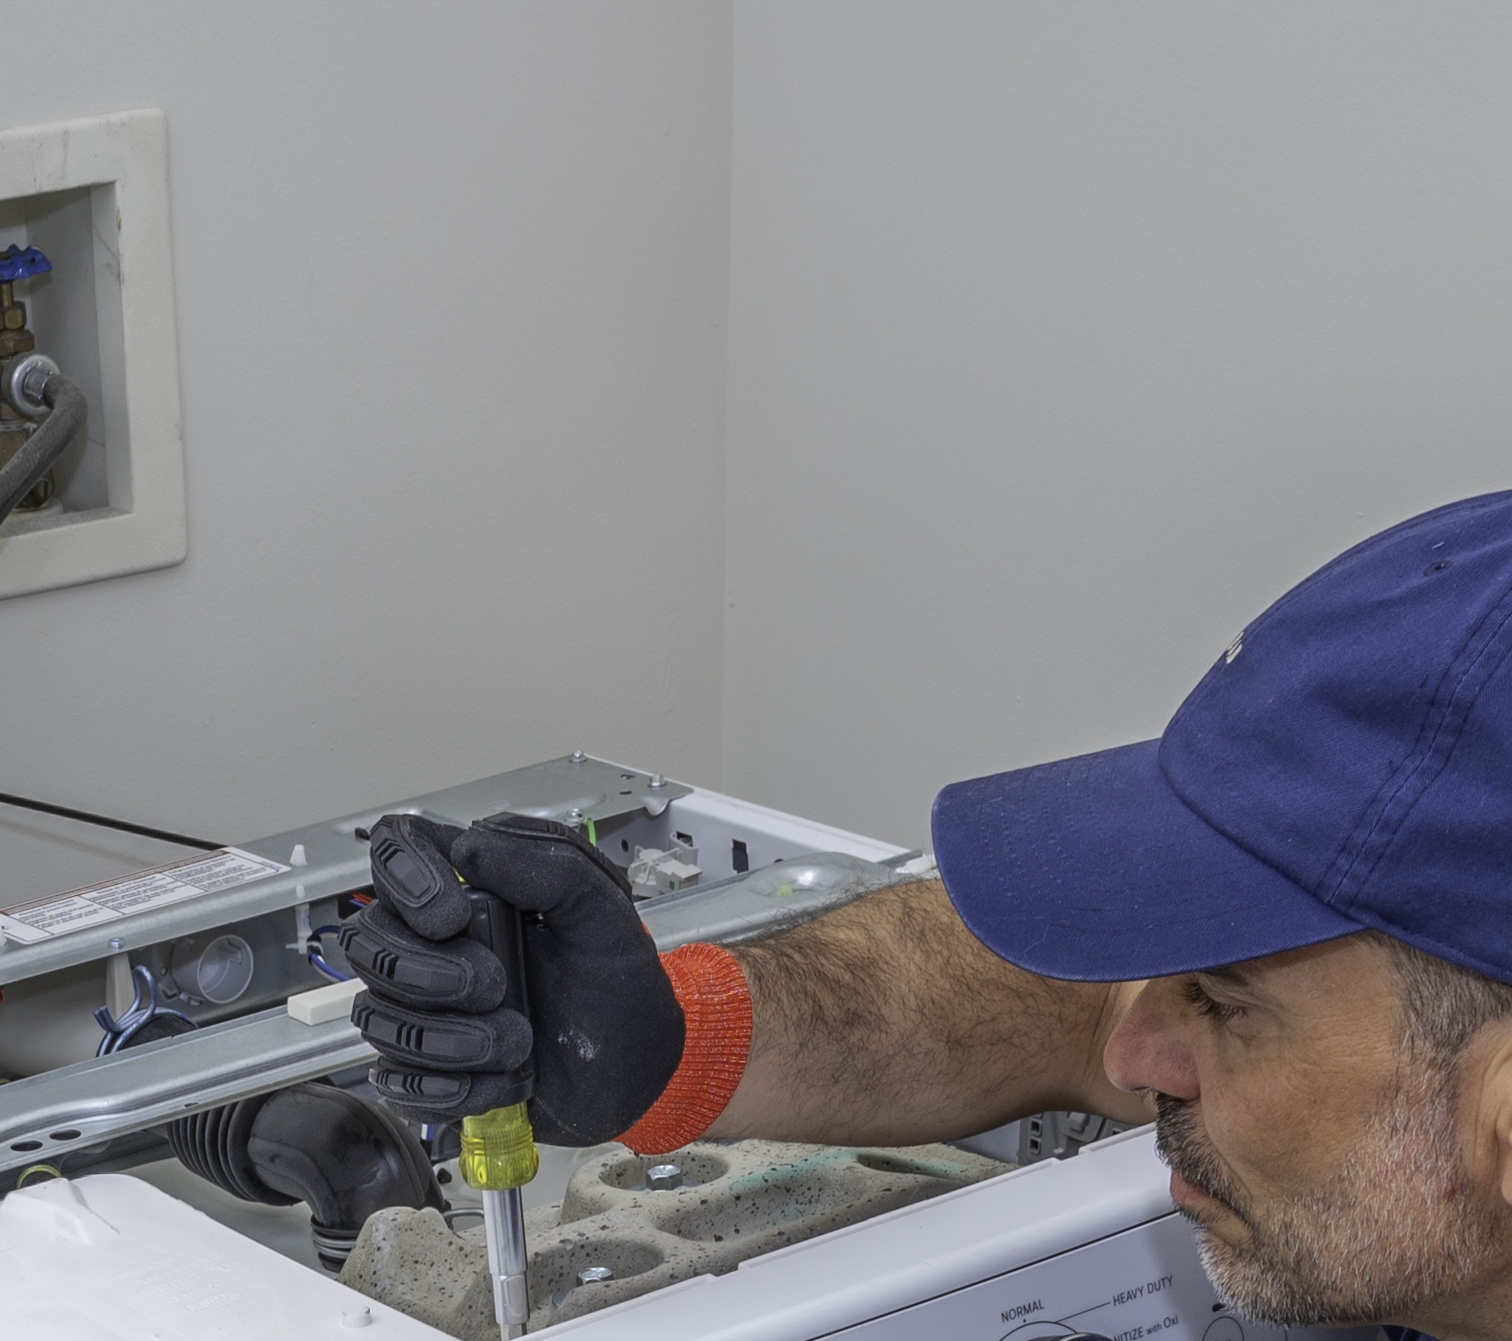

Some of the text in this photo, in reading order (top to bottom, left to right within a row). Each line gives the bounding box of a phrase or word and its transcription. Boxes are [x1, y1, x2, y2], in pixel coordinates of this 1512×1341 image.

[1112, 1275, 1174, 1306] HEAVY DUTY
[1000, 1299, 1046, 1323] NORMAL
